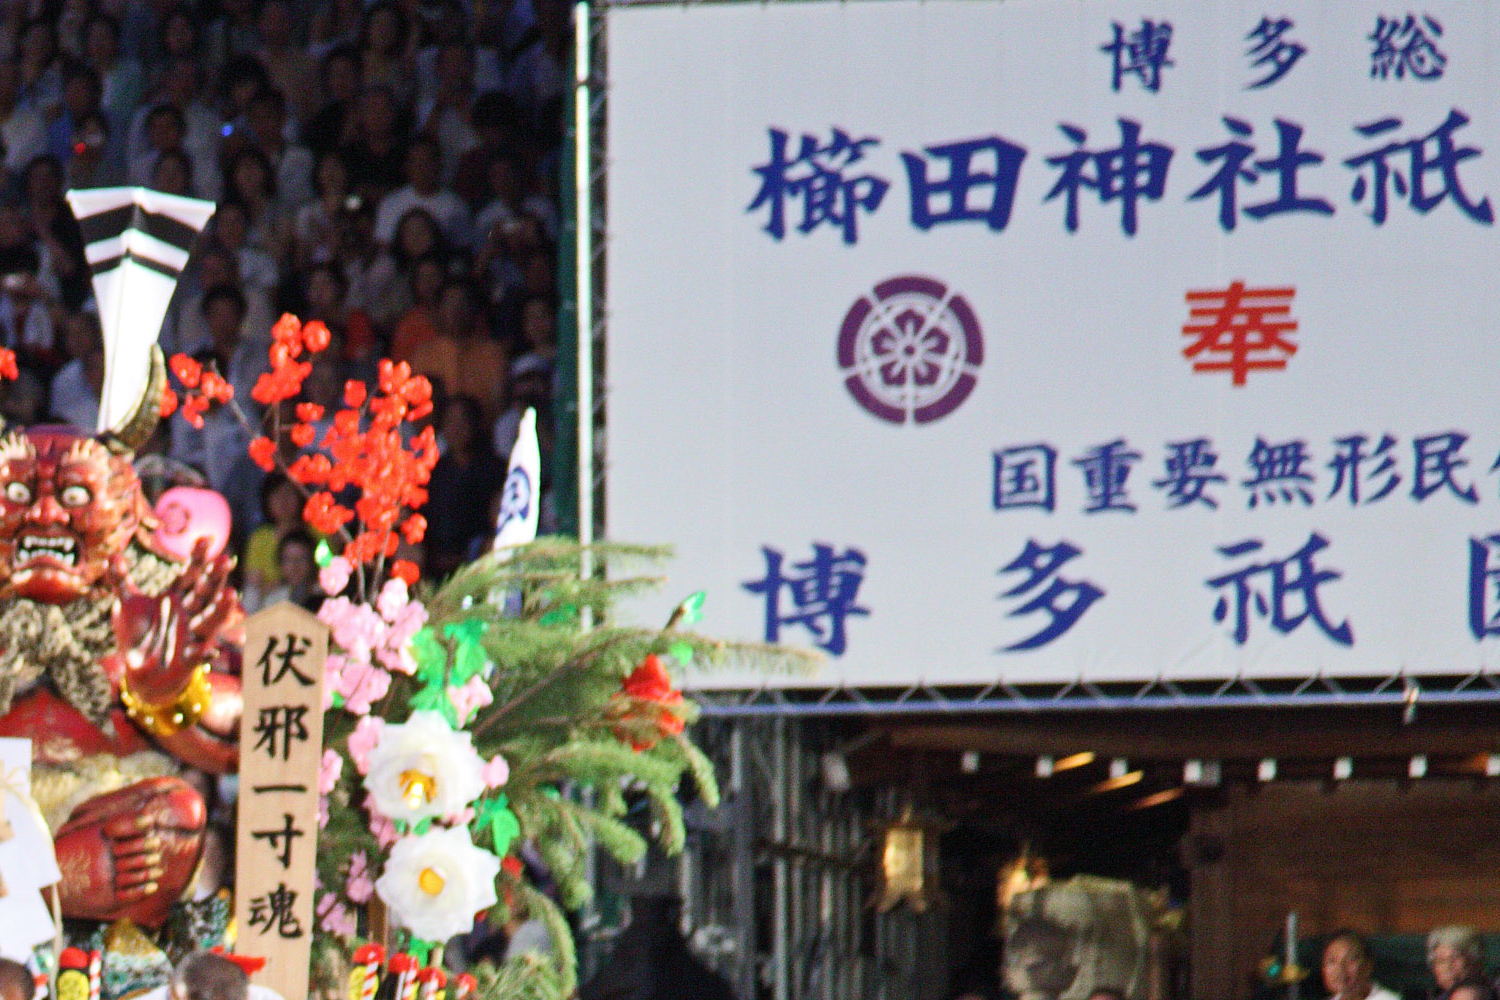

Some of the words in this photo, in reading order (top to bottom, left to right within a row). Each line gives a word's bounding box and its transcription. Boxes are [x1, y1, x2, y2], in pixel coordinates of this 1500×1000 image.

[1098, 13, 1448, 95] 博多総
[745, 108, 1495, 247] 櫛田神社祇
[1181, 281, 1299, 387] 奉
[990, 431, 1500, 515] 国重要無形民
[247, 633, 316, 939] 伏邪一寸魂
